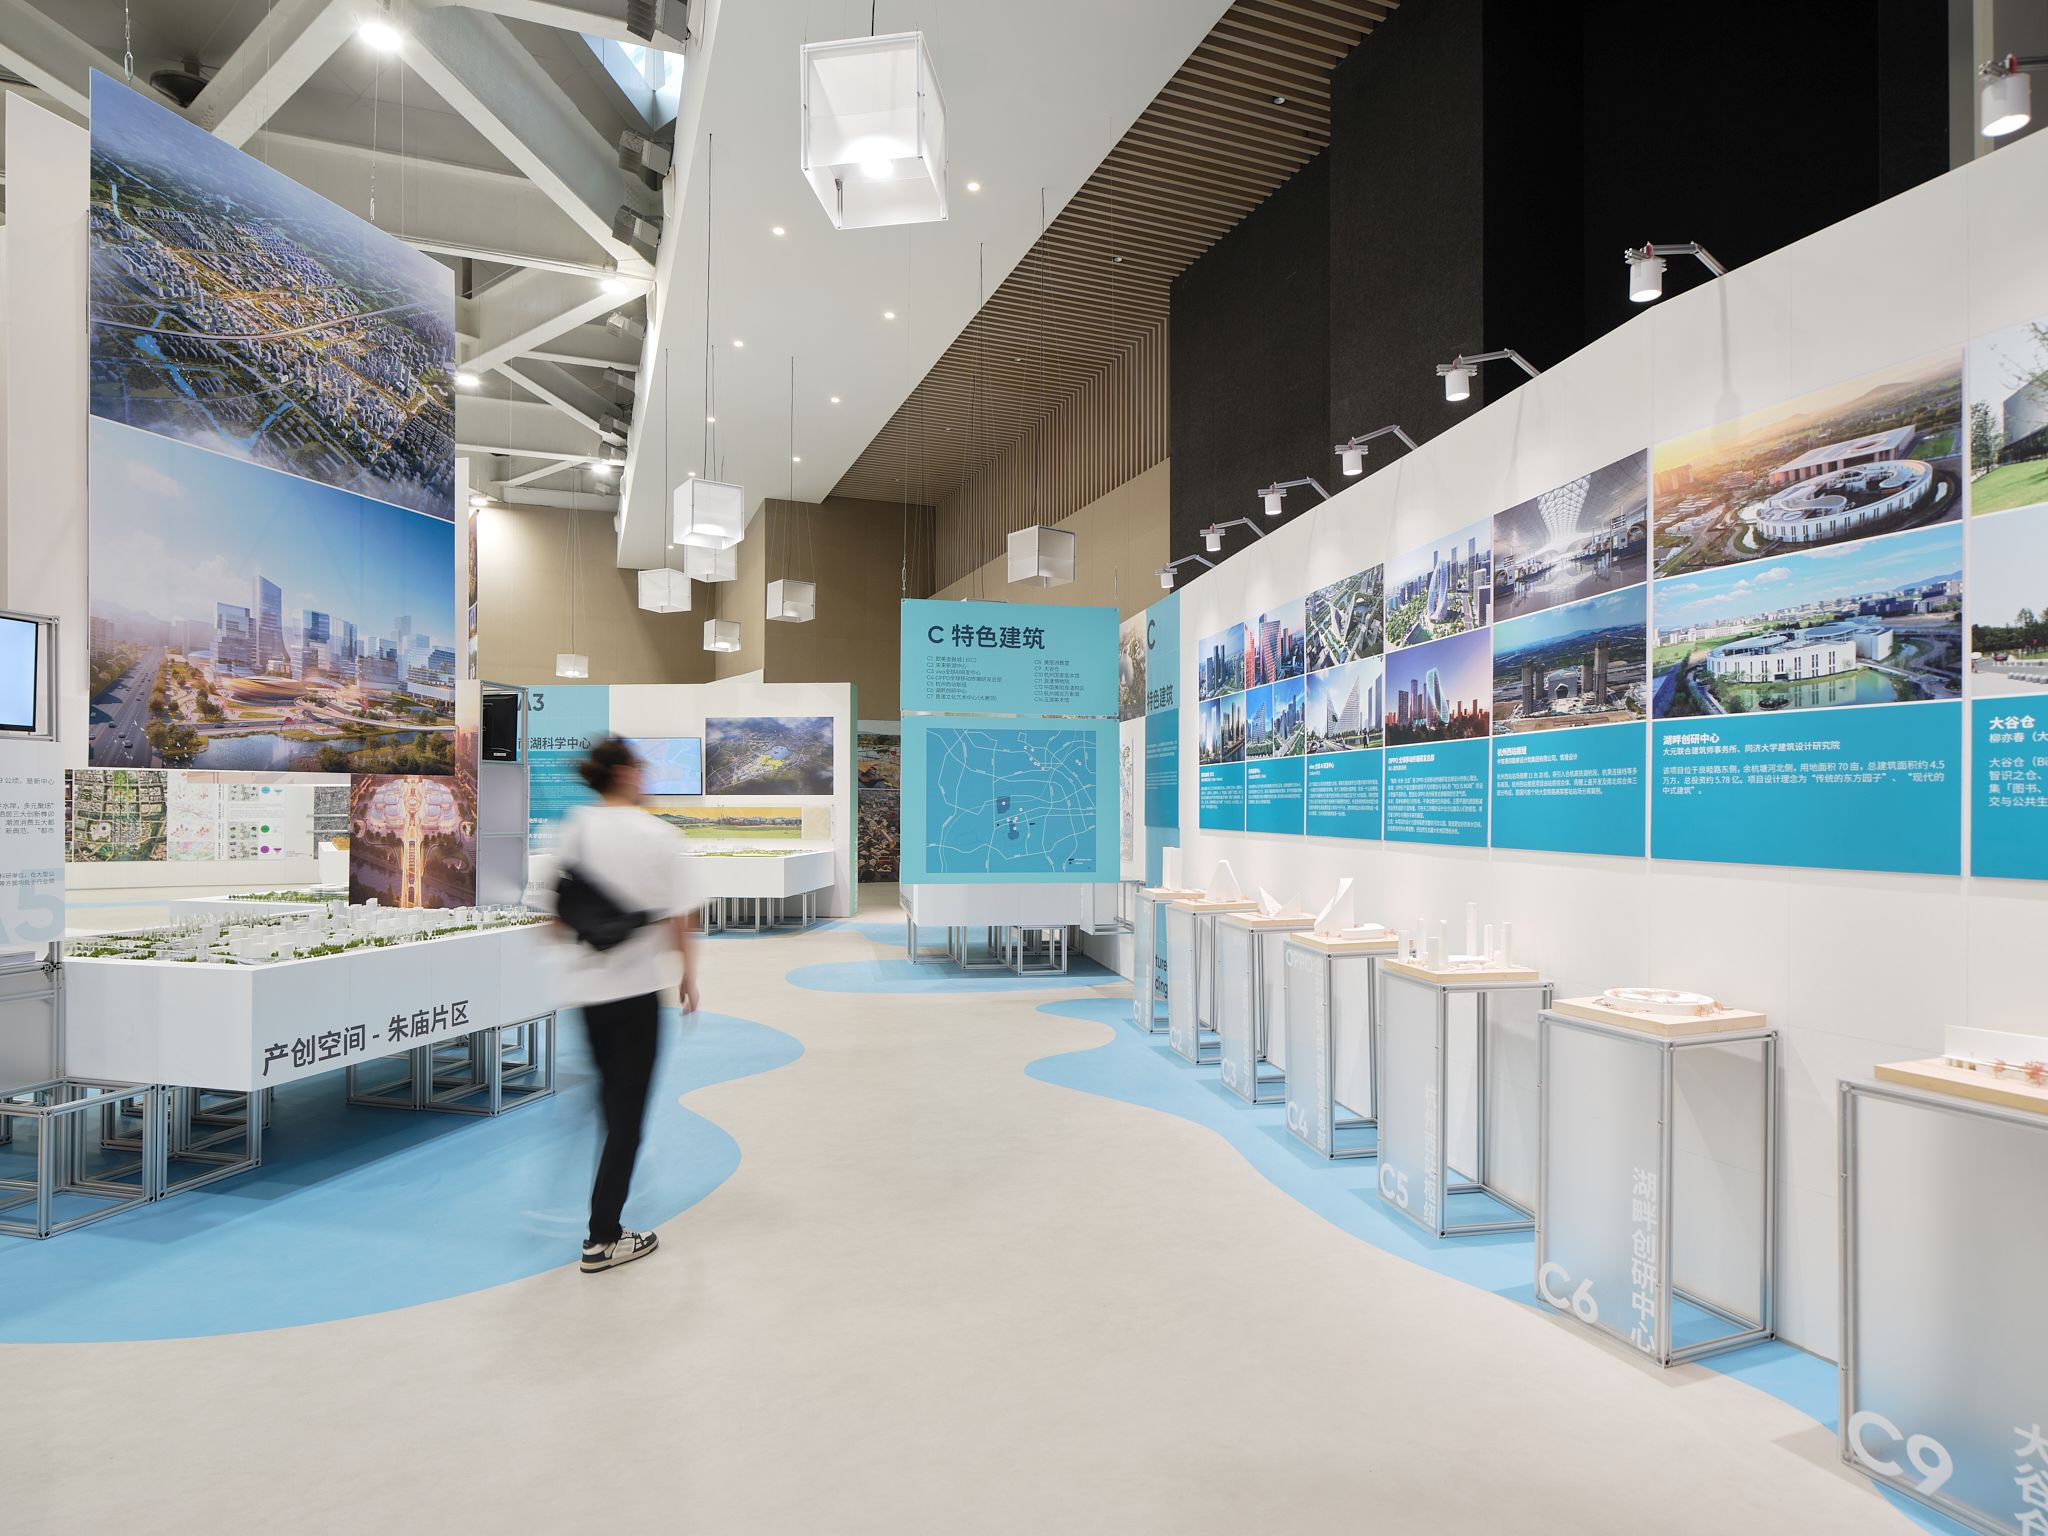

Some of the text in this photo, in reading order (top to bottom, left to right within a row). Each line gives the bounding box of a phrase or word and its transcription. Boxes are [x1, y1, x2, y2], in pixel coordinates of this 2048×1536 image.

[927, 623, 1046, 650] C 特色建筑
[1147, 619, 1155, 650] C
[1146, 683, 1174, 711] 特色建筑
[1989, 715, 2036, 730] 大谷仓
[1662, 733, 1720, 746] 湖畔创研中心
[1285, 949, 1313, 973] OPPO
[262, 1024, 366, 1077] 产创空间
[388, 999, 469, 1042] 朱庙片区
[1170, 1026, 1182, 1052] C2
[1222, 1057, 1237, 1088] C3
[1286, 1100, 1308, 1138] C4
[1379, 1162, 1409, 1209] C5
[1630, 1166, 1658, 1353] 湖畔创研中心
[1538, 1261, 1599, 1324] C6
[1847, 1410, 1954, 1497] C9
